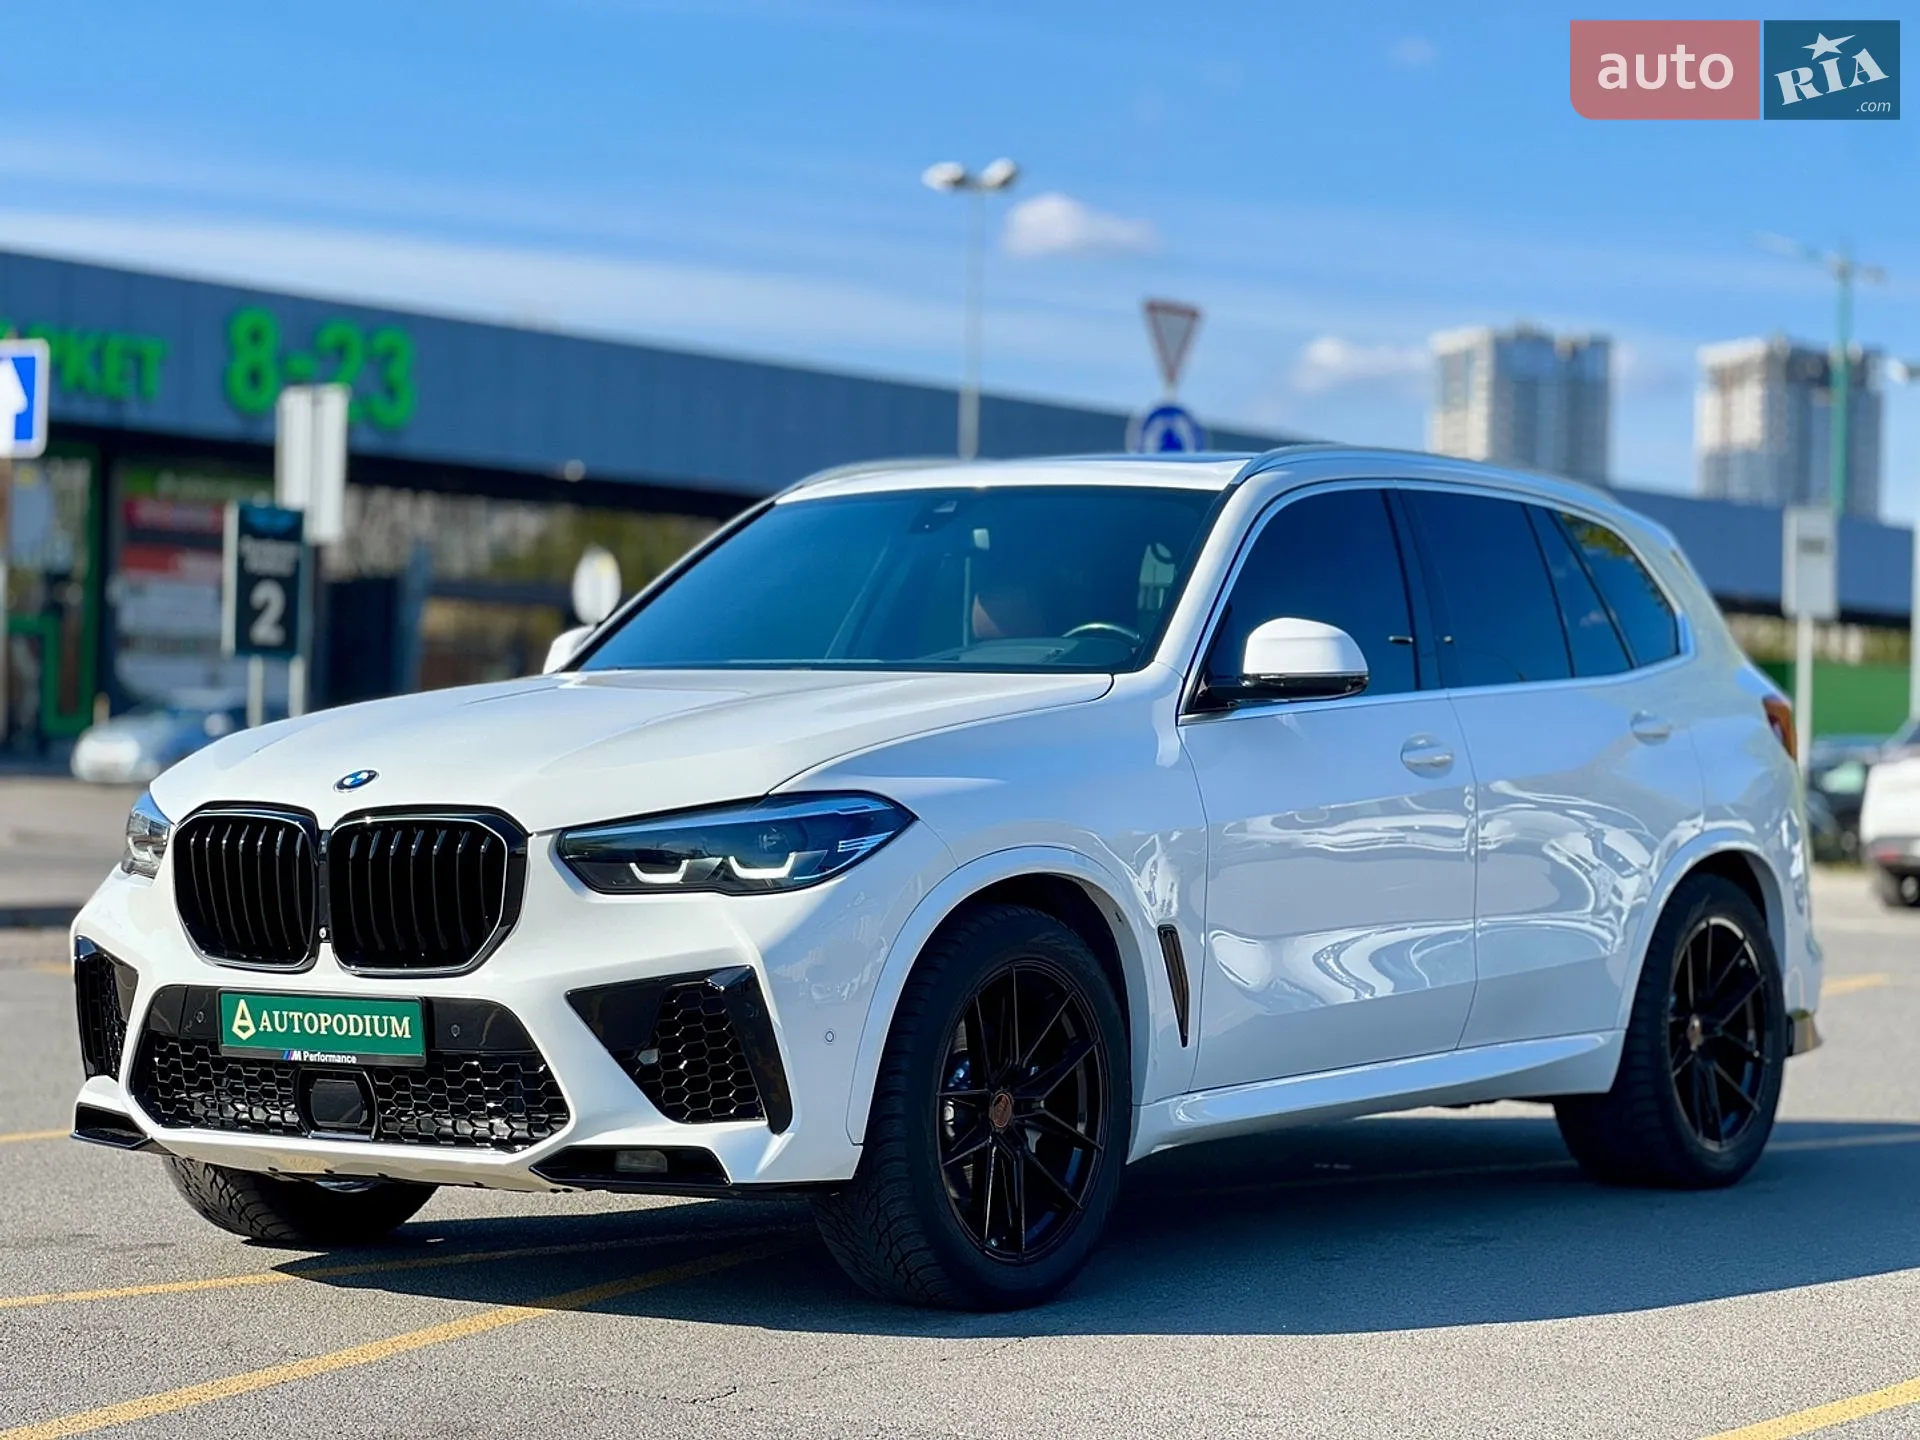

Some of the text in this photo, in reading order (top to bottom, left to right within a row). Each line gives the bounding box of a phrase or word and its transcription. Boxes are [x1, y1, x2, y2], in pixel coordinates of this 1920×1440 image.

[227, 308, 415, 428] 8-23
[251, 580, 285, 645] 2
[258, 1010, 411, 1038] AUTOPODIUM
[302, 1051, 357, 1063] Performance
